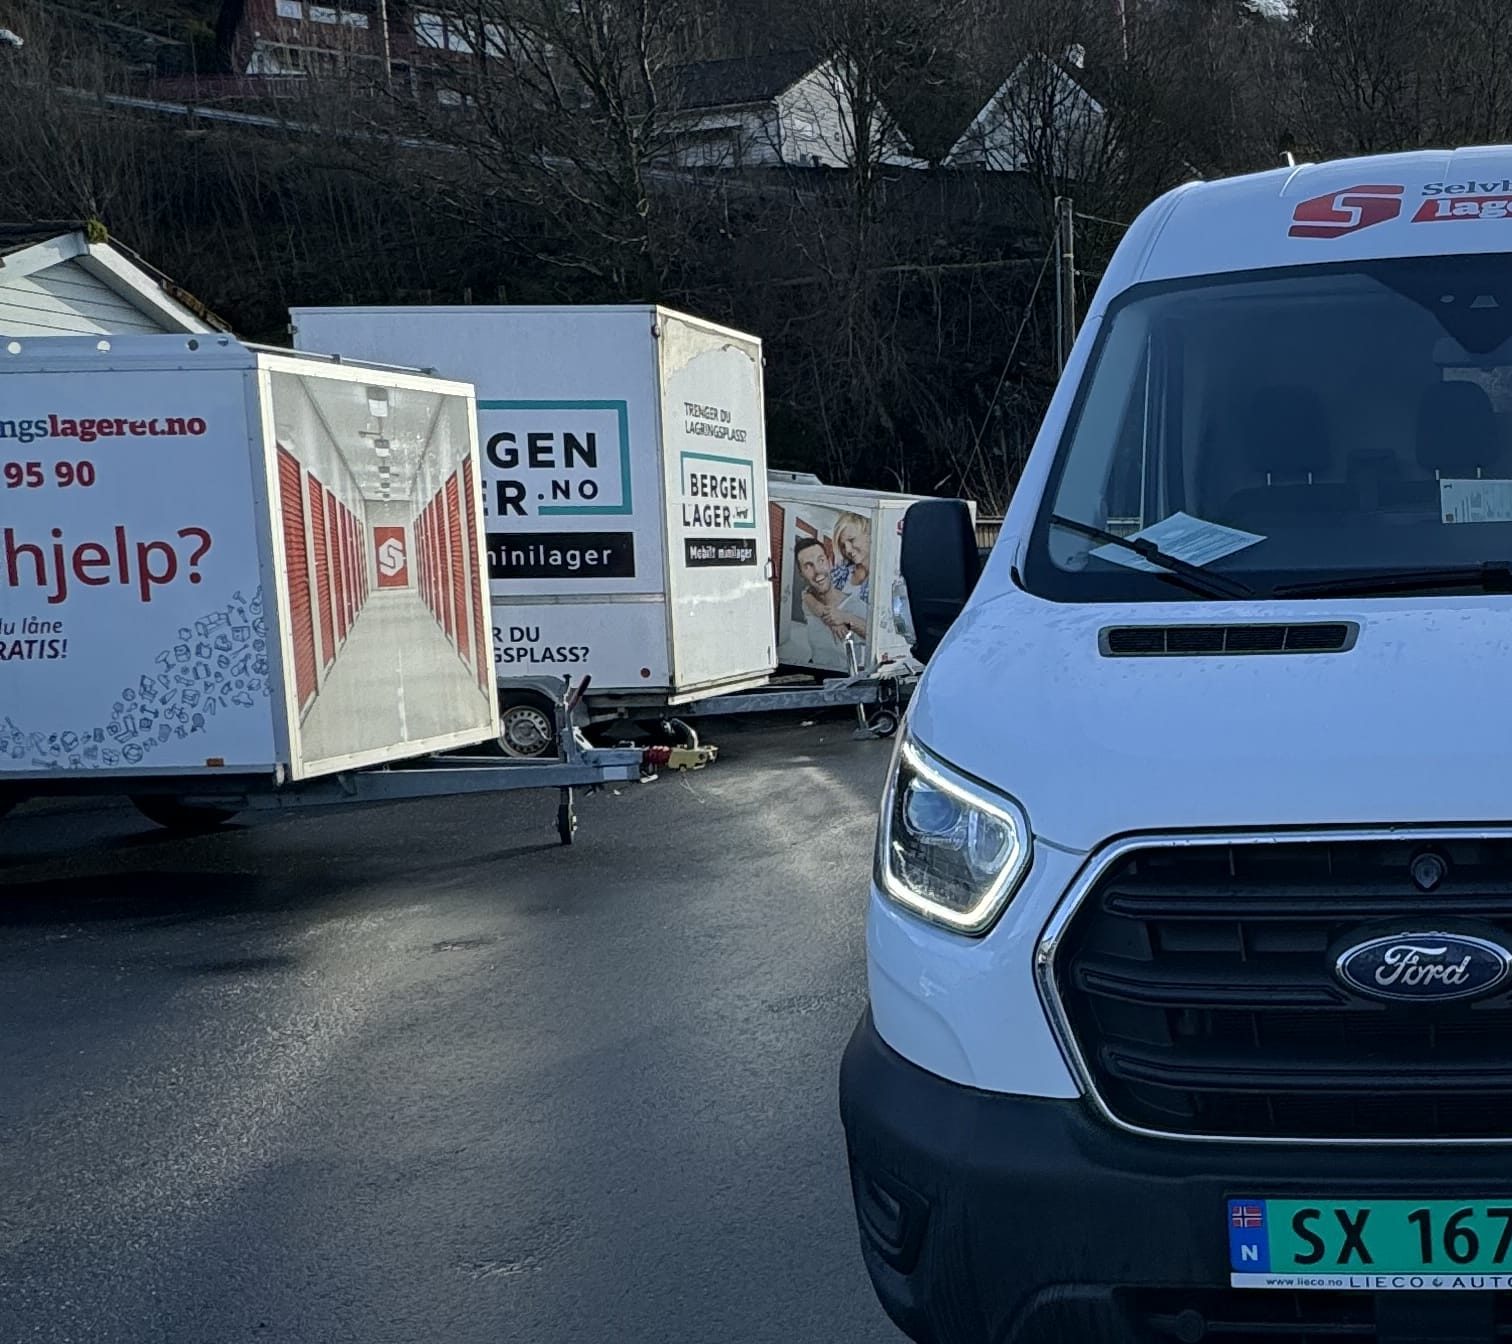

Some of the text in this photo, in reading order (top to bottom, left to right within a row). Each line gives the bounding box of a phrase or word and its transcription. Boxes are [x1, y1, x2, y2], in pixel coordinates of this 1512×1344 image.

[486, 431, 598, 469] GEN
[4, 460, 96, 488] 95 90
[690, 473, 748, 500] BERGEN
[4, 525, 213, 604] hjelp?
[22, 615, 63, 635] låne
[509, 626, 540, 643] DU
[1375, 945, 1472, 986] Ford
[1241, 1244, 1259, 1261] N
[1291, 1208, 1374, 1265] SX
[1350, 1276, 1424, 1288] LIECO
